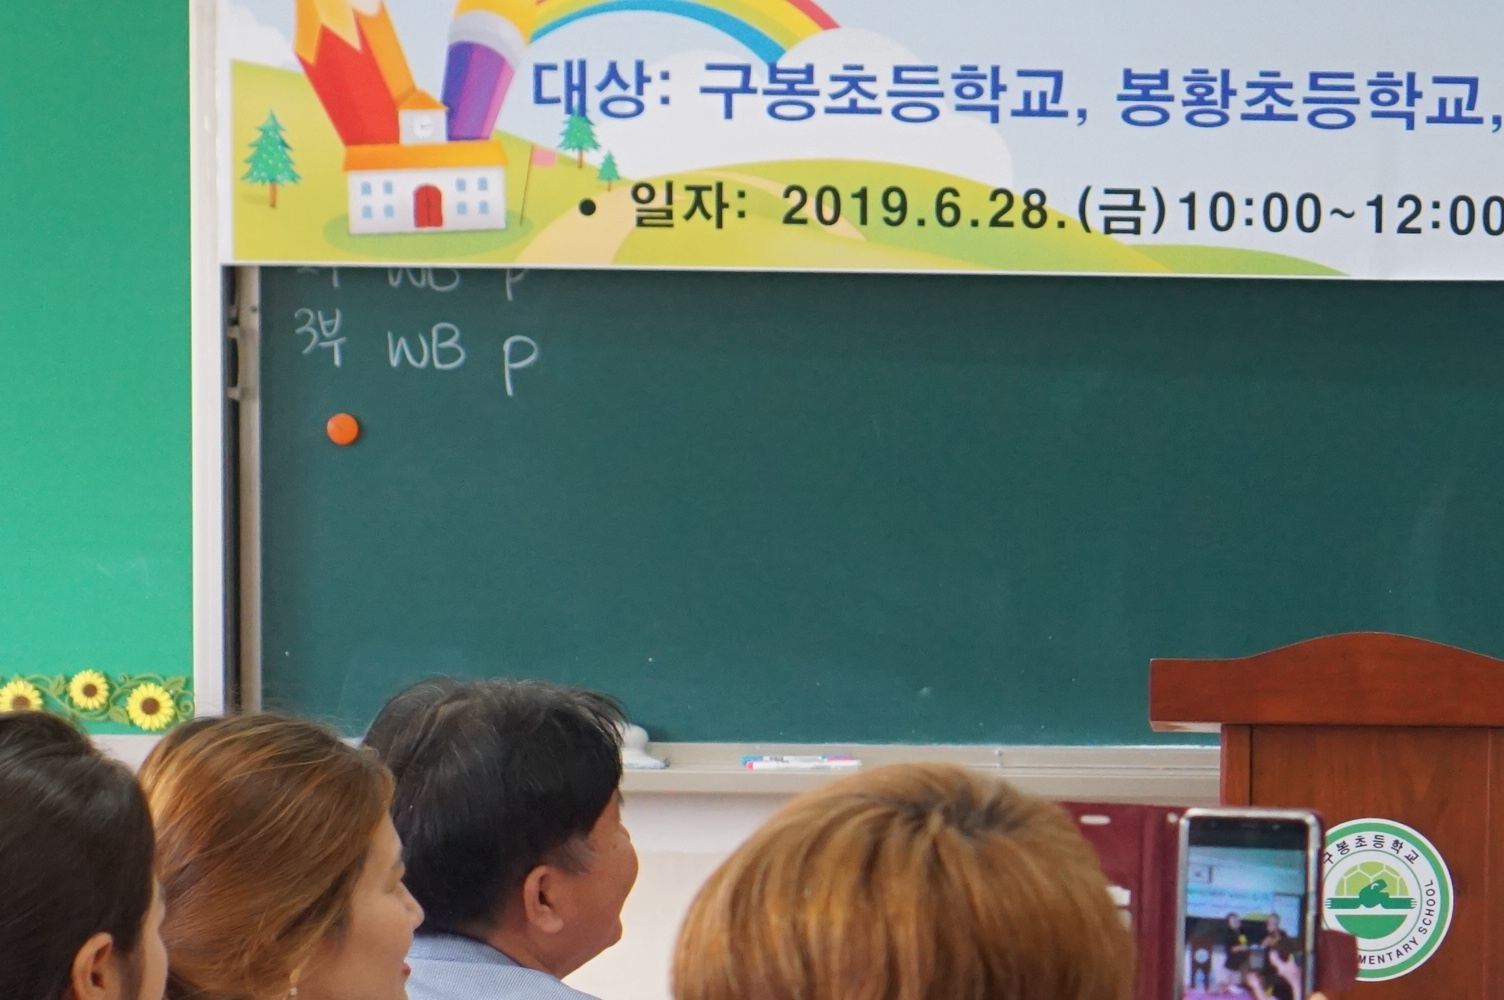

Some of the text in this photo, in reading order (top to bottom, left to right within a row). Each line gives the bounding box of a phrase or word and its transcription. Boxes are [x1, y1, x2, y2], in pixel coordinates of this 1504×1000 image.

[533, 57, 673, 122] 대상:
[698, 55, 1089, 127] 구봉초등학교,
[1116, 68, 1503, 132] 봉황초등학교,
[631, 181, 748, 230] 일자:
[294, 307, 347, 369] 3부
[387, 321, 467, 371] WB
[1322, 833, 1420, 865] 구봉초등학교
[1358, 879, 1437, 966] MENTARY SCHOOL
